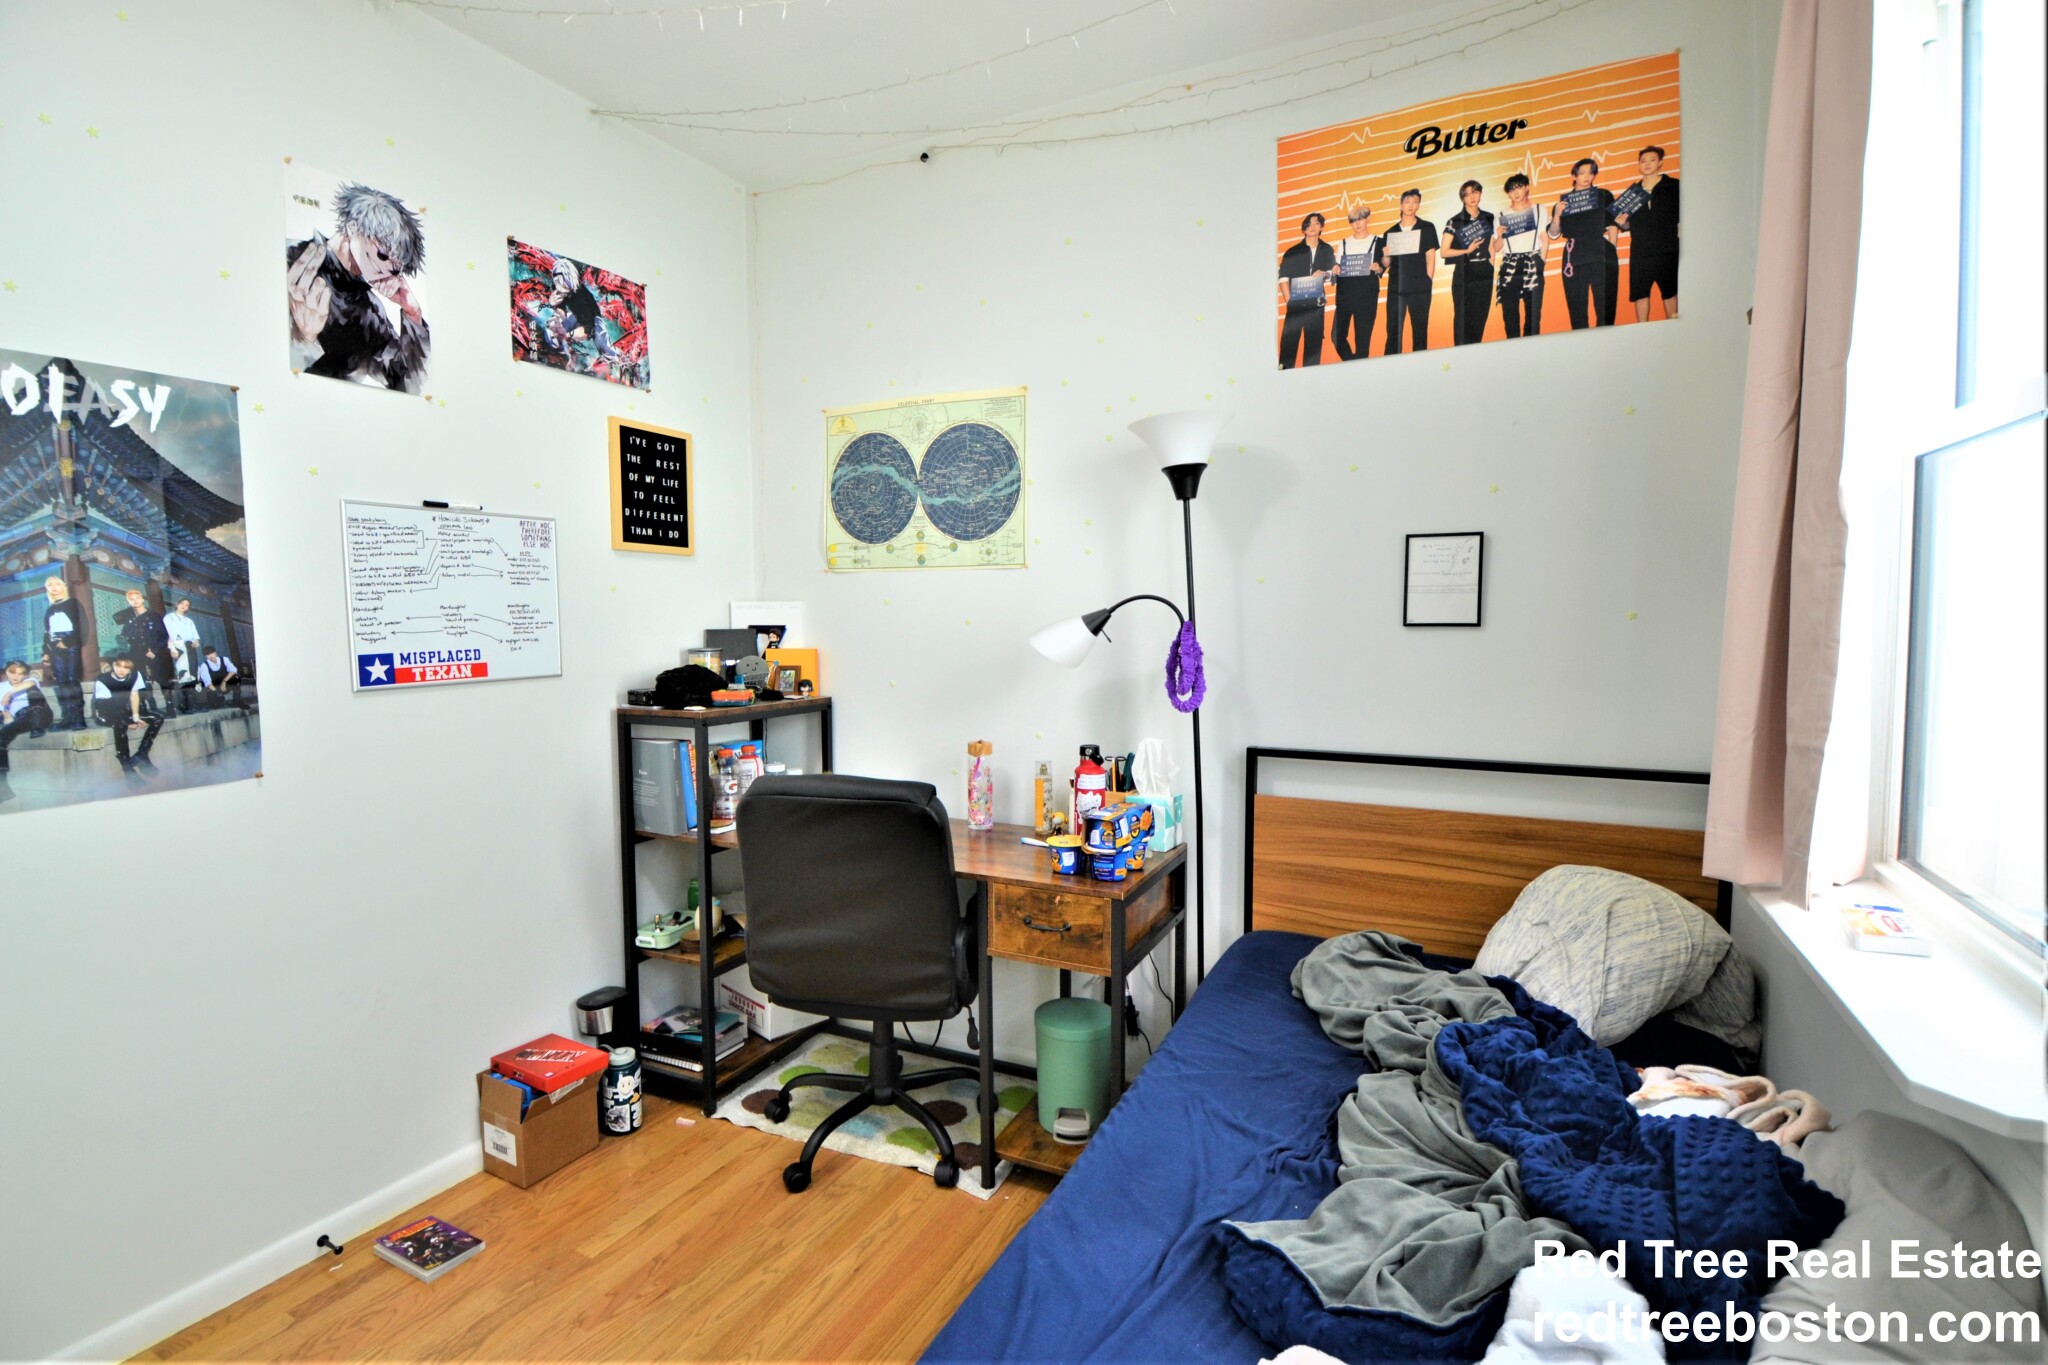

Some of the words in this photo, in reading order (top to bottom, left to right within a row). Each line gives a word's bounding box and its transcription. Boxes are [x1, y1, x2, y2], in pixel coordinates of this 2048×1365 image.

[1404, 119, 1528, 159] Butter
[629, 436, 647, 448] I'VE
[656, 442, 675, 453] GOT
[626, 454, 641, 464] THE
[656, 460, 680, 471] REST
[629, 472, 638, 481] OF
[645, 475, 655, 484] MY
[662, 478, 679, 488] LIFE
[634, 491, 644, 500] TO
[653, 494, 675, 504] FEEL
[625, 507, 684, 523] DIFFERENT
[520, 520, 536, 528] AFTER
[521, 534, 551, 542] SOMETHING
[631, 526, 653, 536] THAN
[668, 530, 679, 539] DO
[399, 649, 481, 665] MISPLACED
[412, 664, 473, 682] TEXAN
